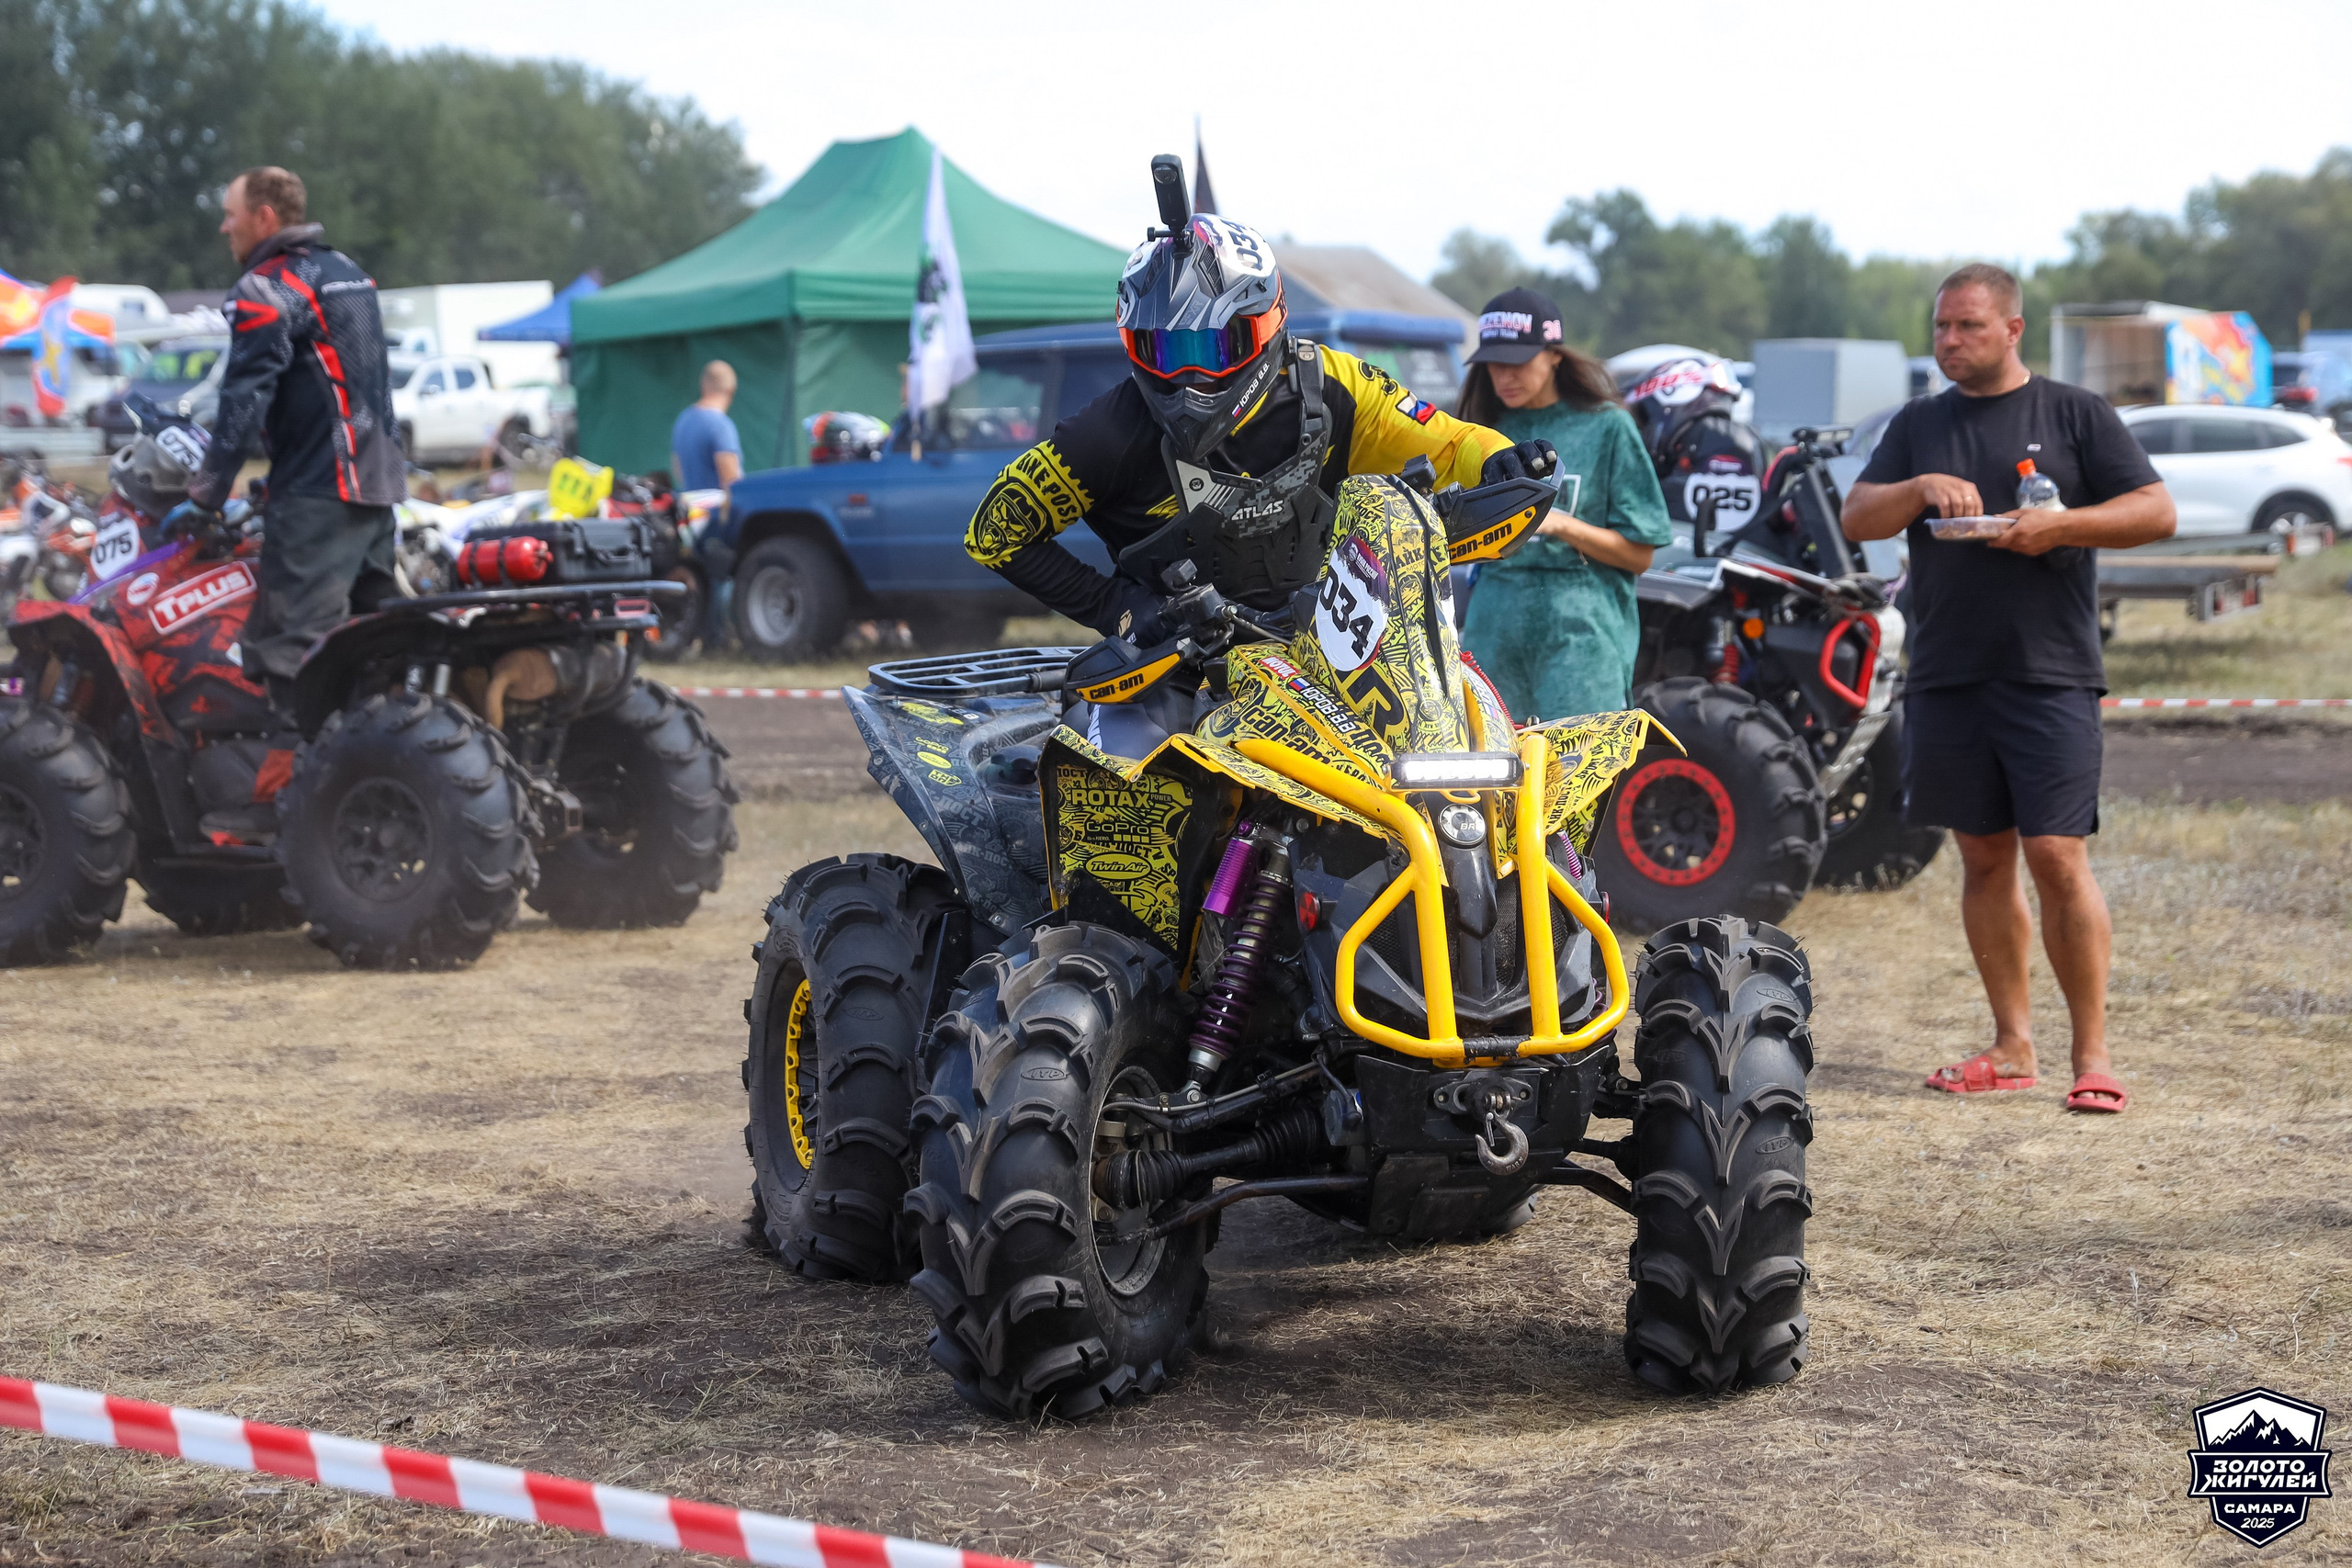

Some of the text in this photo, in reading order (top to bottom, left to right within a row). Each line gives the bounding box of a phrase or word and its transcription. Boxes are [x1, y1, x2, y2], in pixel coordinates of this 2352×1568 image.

[1239, 378, 1260, 408] ЮРОВ
[1231, 501, 1283, 521] ATLAS
[1692, 485, 1753, 512] 025
[94, 533, 133, 565] 075
[1449, 523, 1513, 559] can-am
[153, 570, 250, 623] TPLUS
[1320, 564, 1374, 660] 034
[1262, 655, 1297, 679] MOTUL
[1089, 672, 1145, 700] can-am
[1241, 706, 1331, 765] can-am
[1071, 789, 1171, 808] ROTAX POWER
[1086, 821, 1149, 835] GoPro
[1091, 862, 1148, 873] Twin Air
